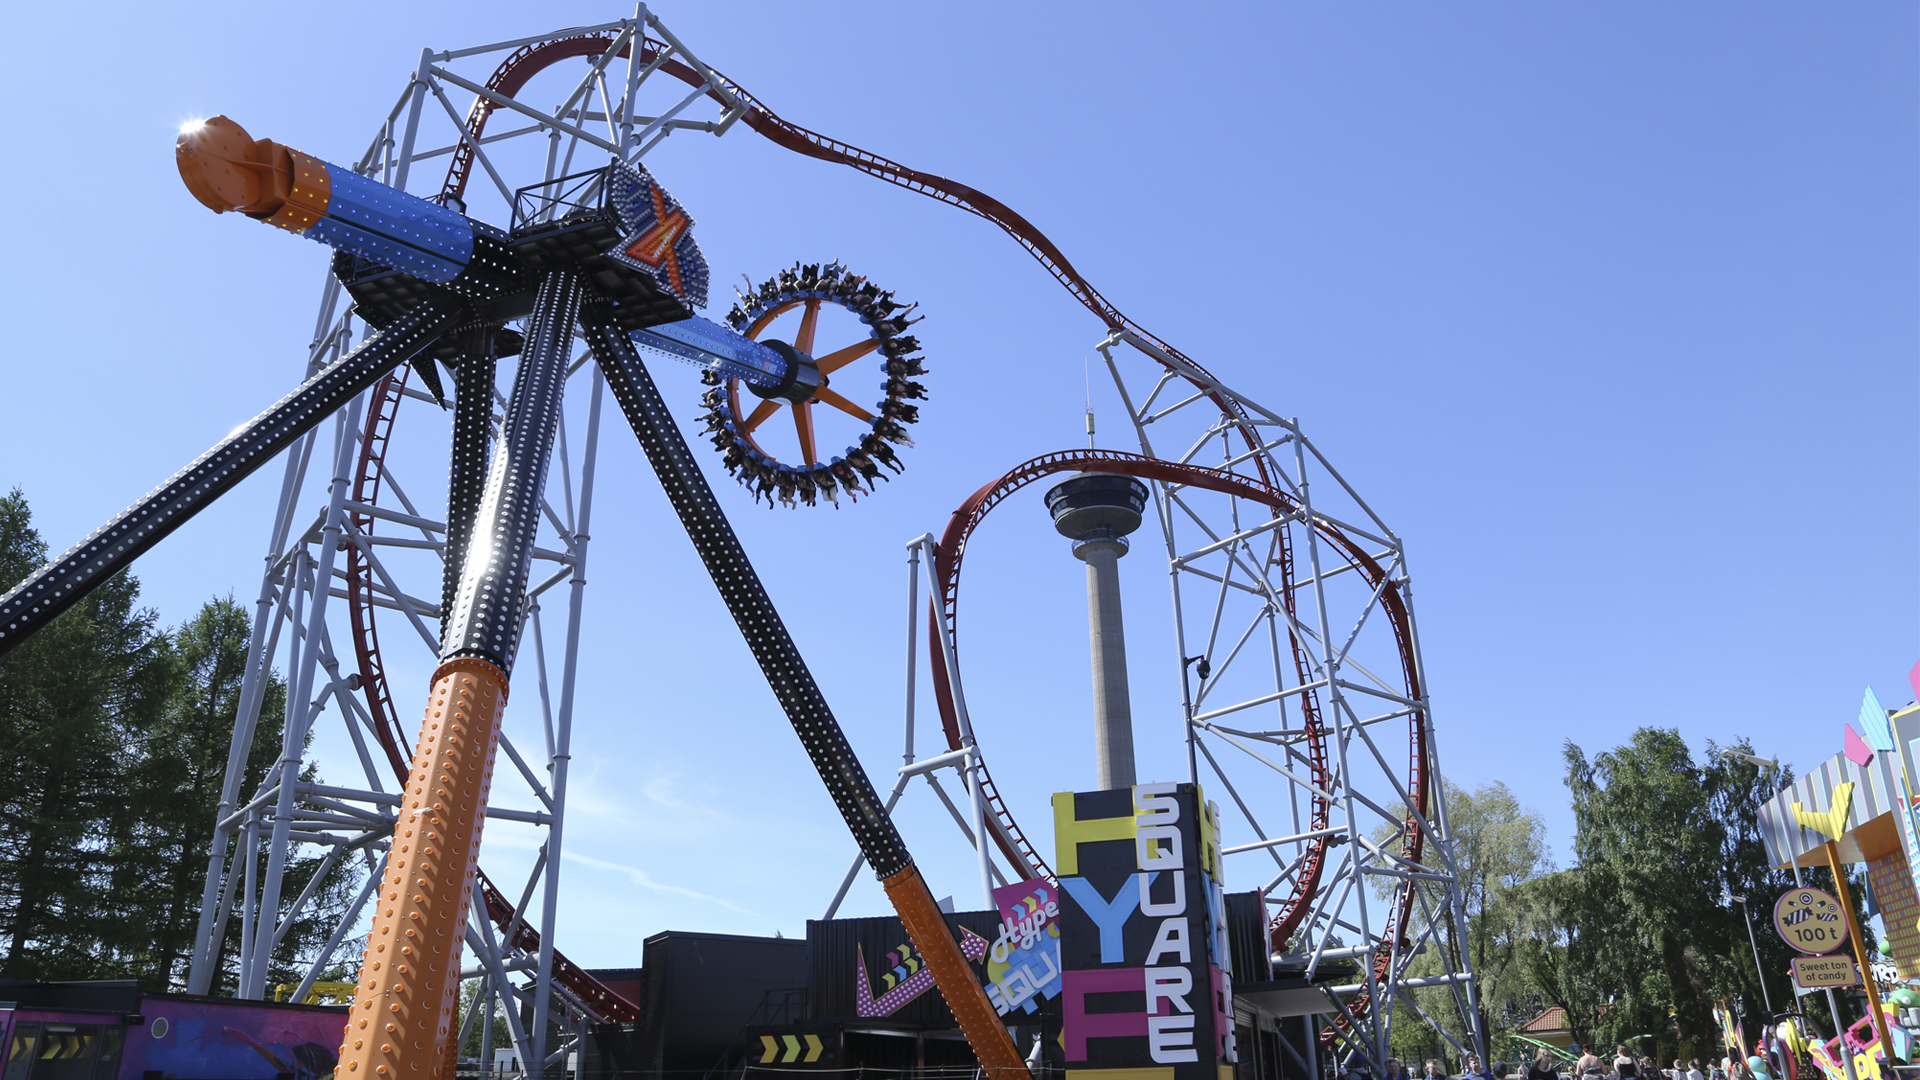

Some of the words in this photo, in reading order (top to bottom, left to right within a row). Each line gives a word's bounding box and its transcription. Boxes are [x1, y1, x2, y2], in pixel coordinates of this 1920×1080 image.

[990, 901, 1060, 964] Hype
[1052, 788, 1174, 1080] HYP
[1132, 781, 1199, 1065] SQUARE
[1794, 927, 1826, 942] 100
[1829, 927, 1838, 940] t
[985, 939, 1062, 1017] SQU
[1800, 962, 1830, 972] Sweet
[1830, 961, 1848, 970] ton
[1805, 972, 1816, 982] of
[1817, 970, 1847, 981] candy
